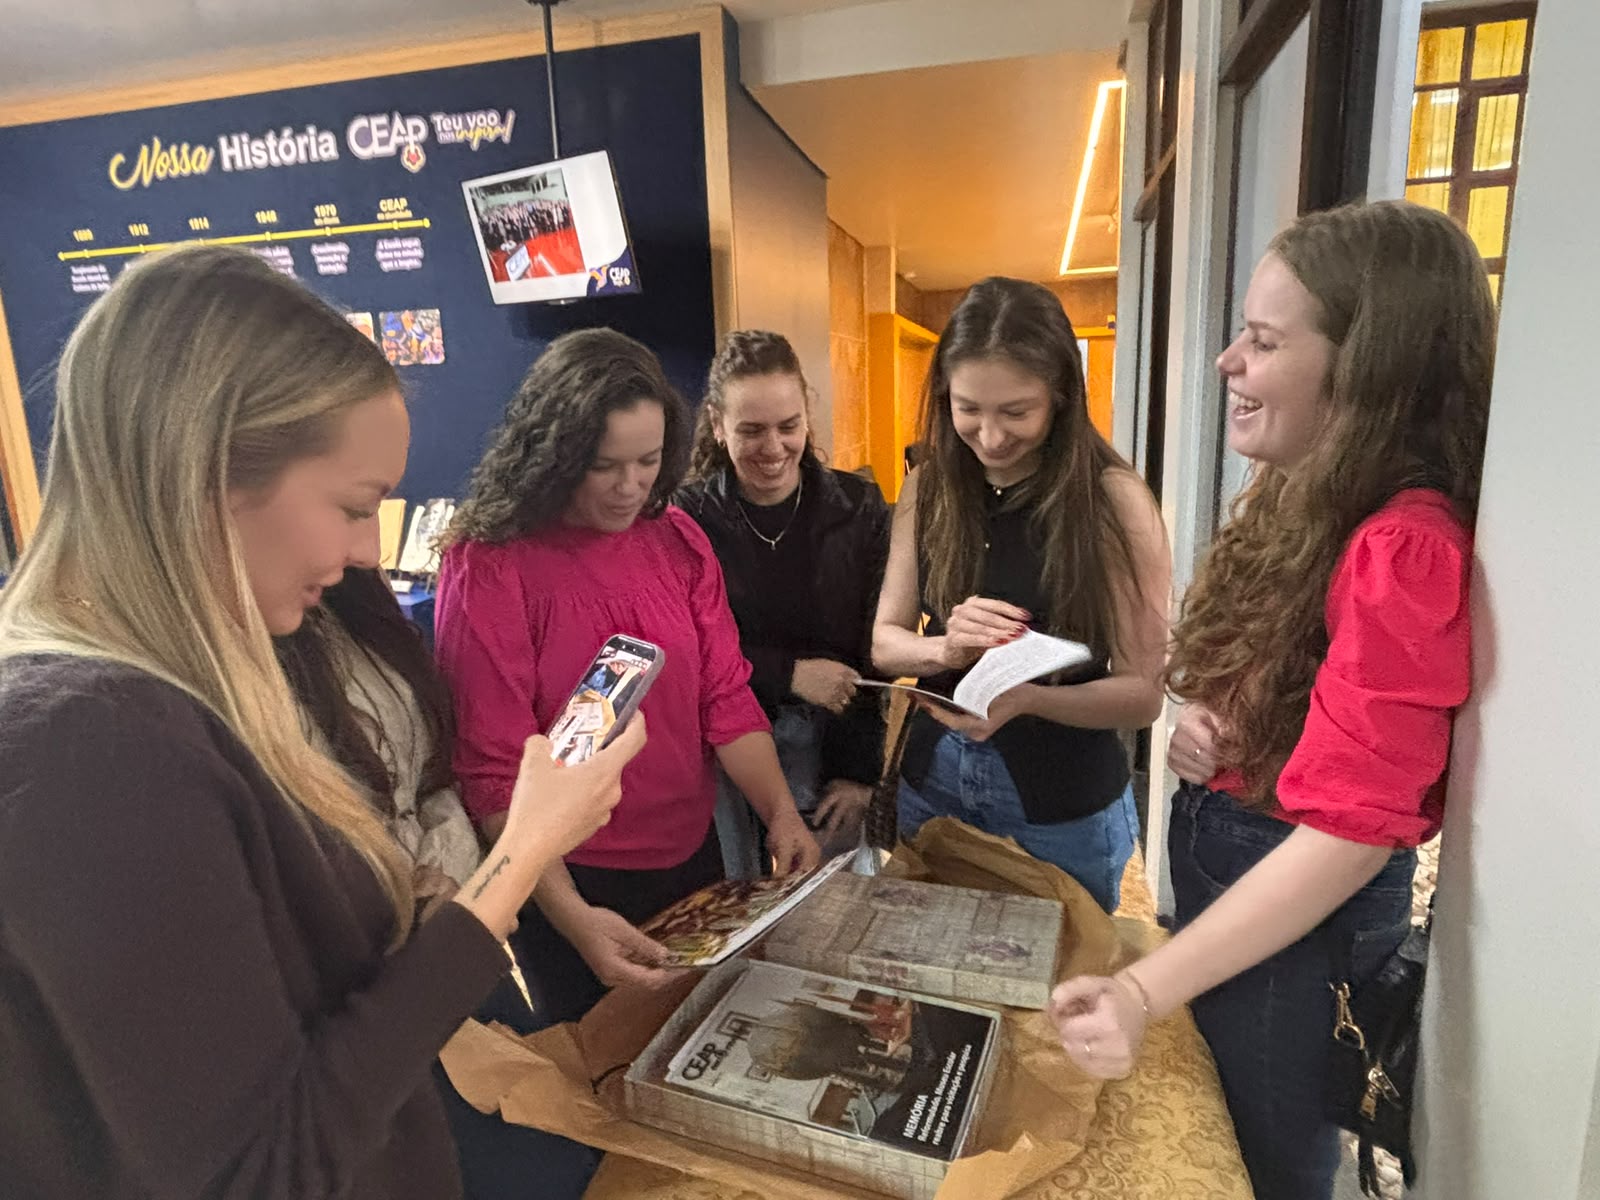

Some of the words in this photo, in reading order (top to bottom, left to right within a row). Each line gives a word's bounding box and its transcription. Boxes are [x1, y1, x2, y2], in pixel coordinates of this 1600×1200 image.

[348, 111, 427, 160] CEAP
[432, 113, 463, 132] Teu
[109, 136, 214, 190] Nossa
[218, 124, 340, 172] História
[379, 197, 409, 213] CEAP
[958, 1044, 973, 1072] pesquisa
[934, 1073, 950, 1096] Museu
[942, 1051, 957, 1074] Escolar
[945, 1075, 962, 1105] visitação
[902, 1094, 929, 1139] MEMÓRIA
[940, 1105, 952, 1123] para
[932, 1121, 946, 1146] reabre
